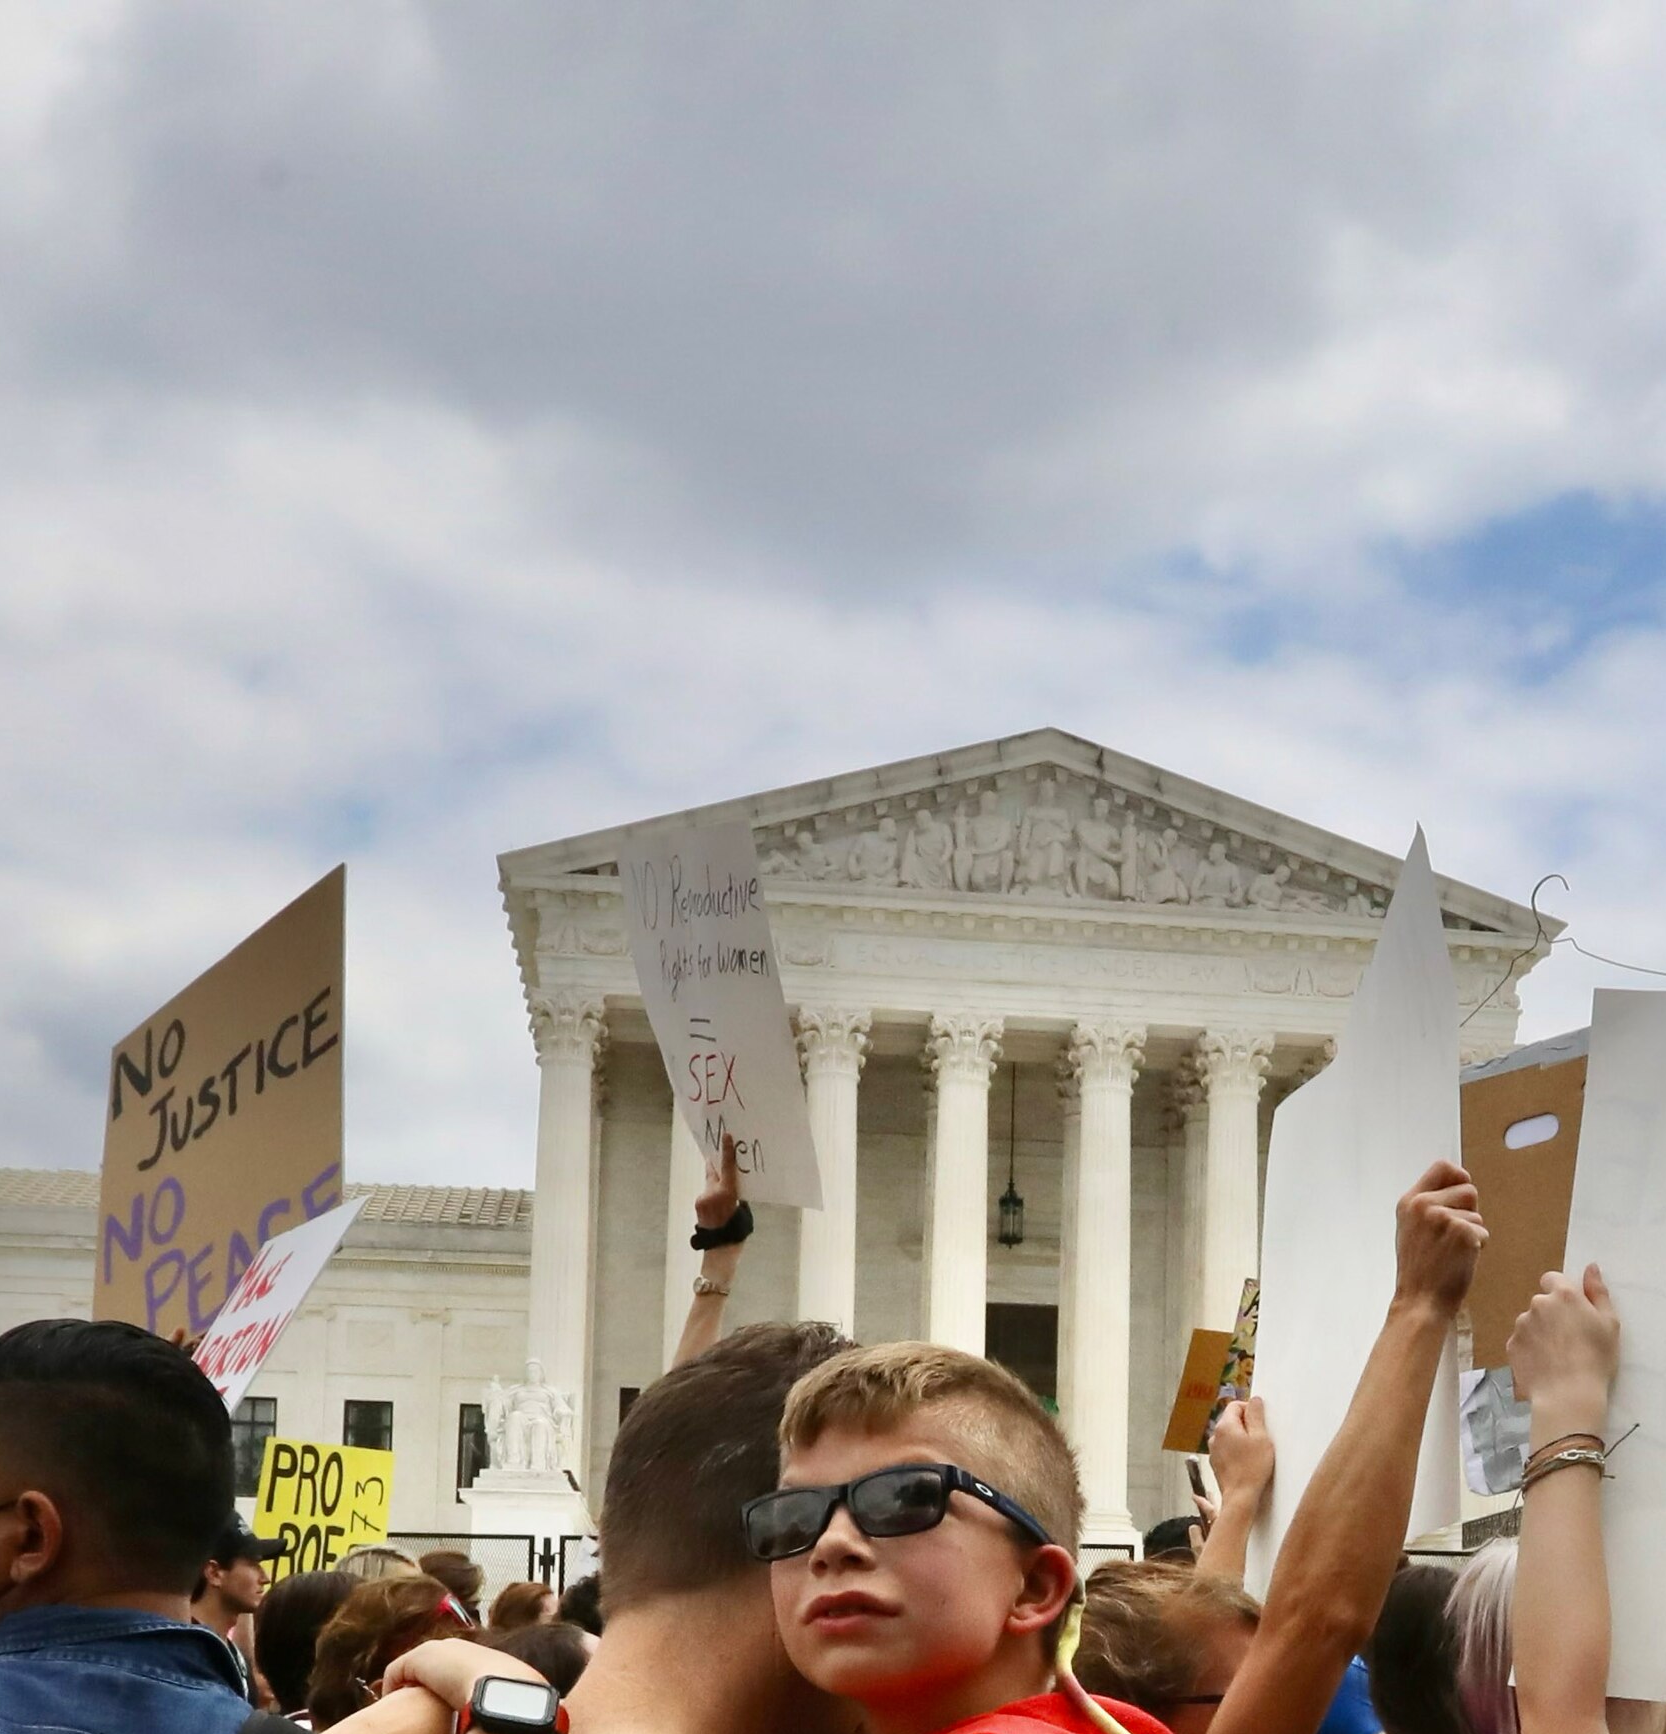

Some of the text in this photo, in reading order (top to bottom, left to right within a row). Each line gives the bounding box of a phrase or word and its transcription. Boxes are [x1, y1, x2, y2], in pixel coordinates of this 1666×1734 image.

[670, 854, 761, 928] Reproductive
[717, 940, 770, 977] Women
[111, 1019, 186, 1121] NO
[137, 986, 339, 1171] JUSTICE
[688, 1051, 745, 1111] SEX
[102, 1175, 186, 1286] NO
[265, 1443, 344, 1517] PRO
[271, 1522, 346, 1586] ROE
